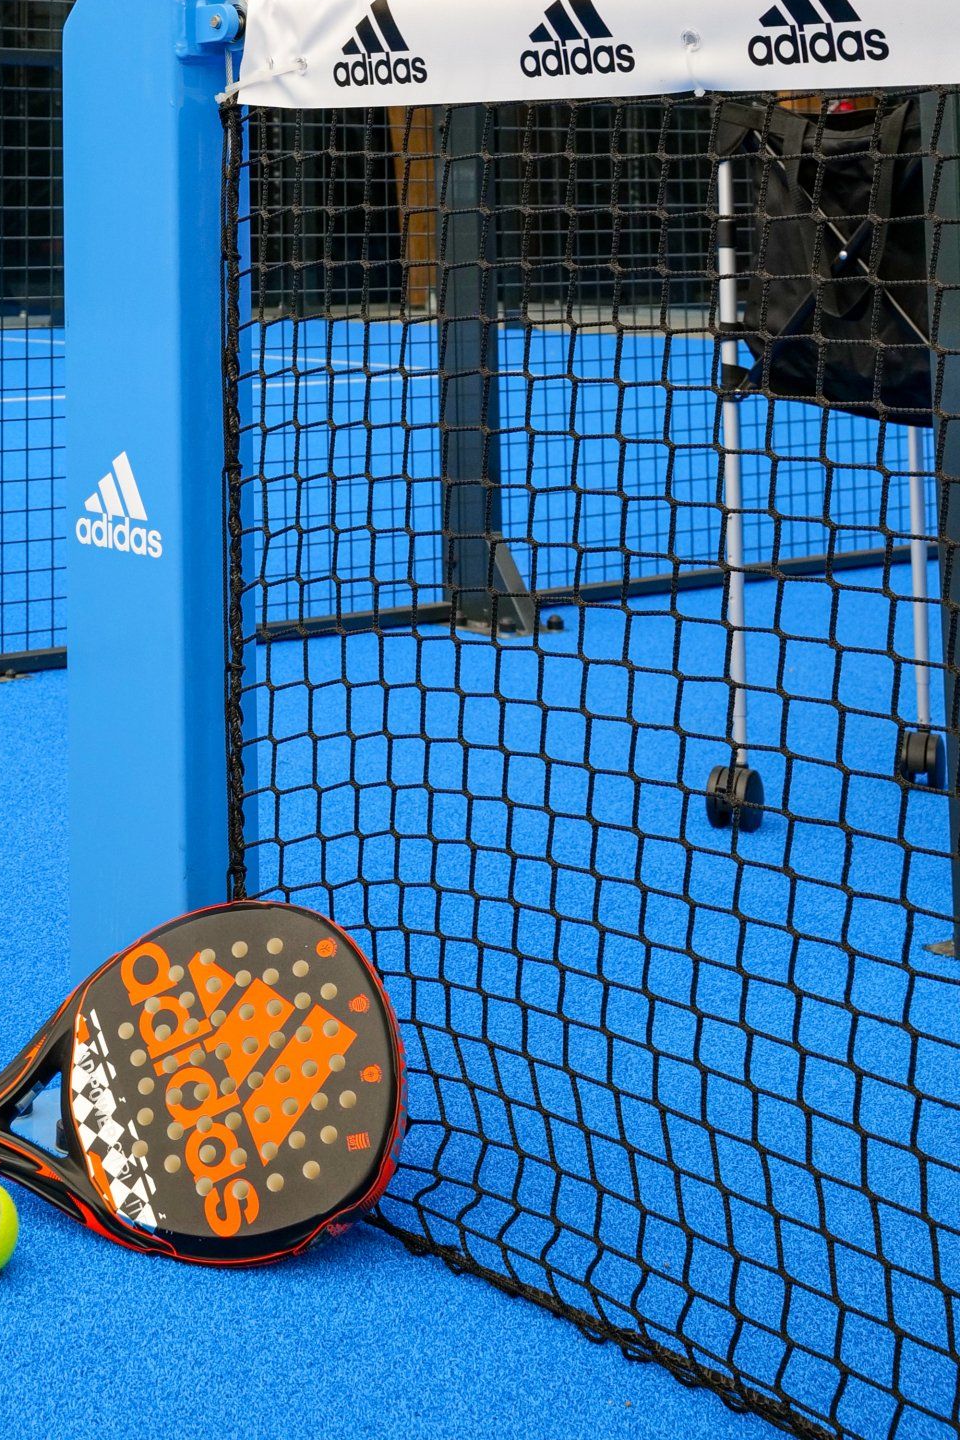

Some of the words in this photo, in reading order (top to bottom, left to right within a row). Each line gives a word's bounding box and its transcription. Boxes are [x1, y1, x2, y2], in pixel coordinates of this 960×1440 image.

[519, 34, 636, 79] adidas
[746, 19, 891, 67] adidas
[332, 49, 428, 87] adidas
[75, 513, 163, 559] adidas
[120, 940, 261, 1238] adidas
